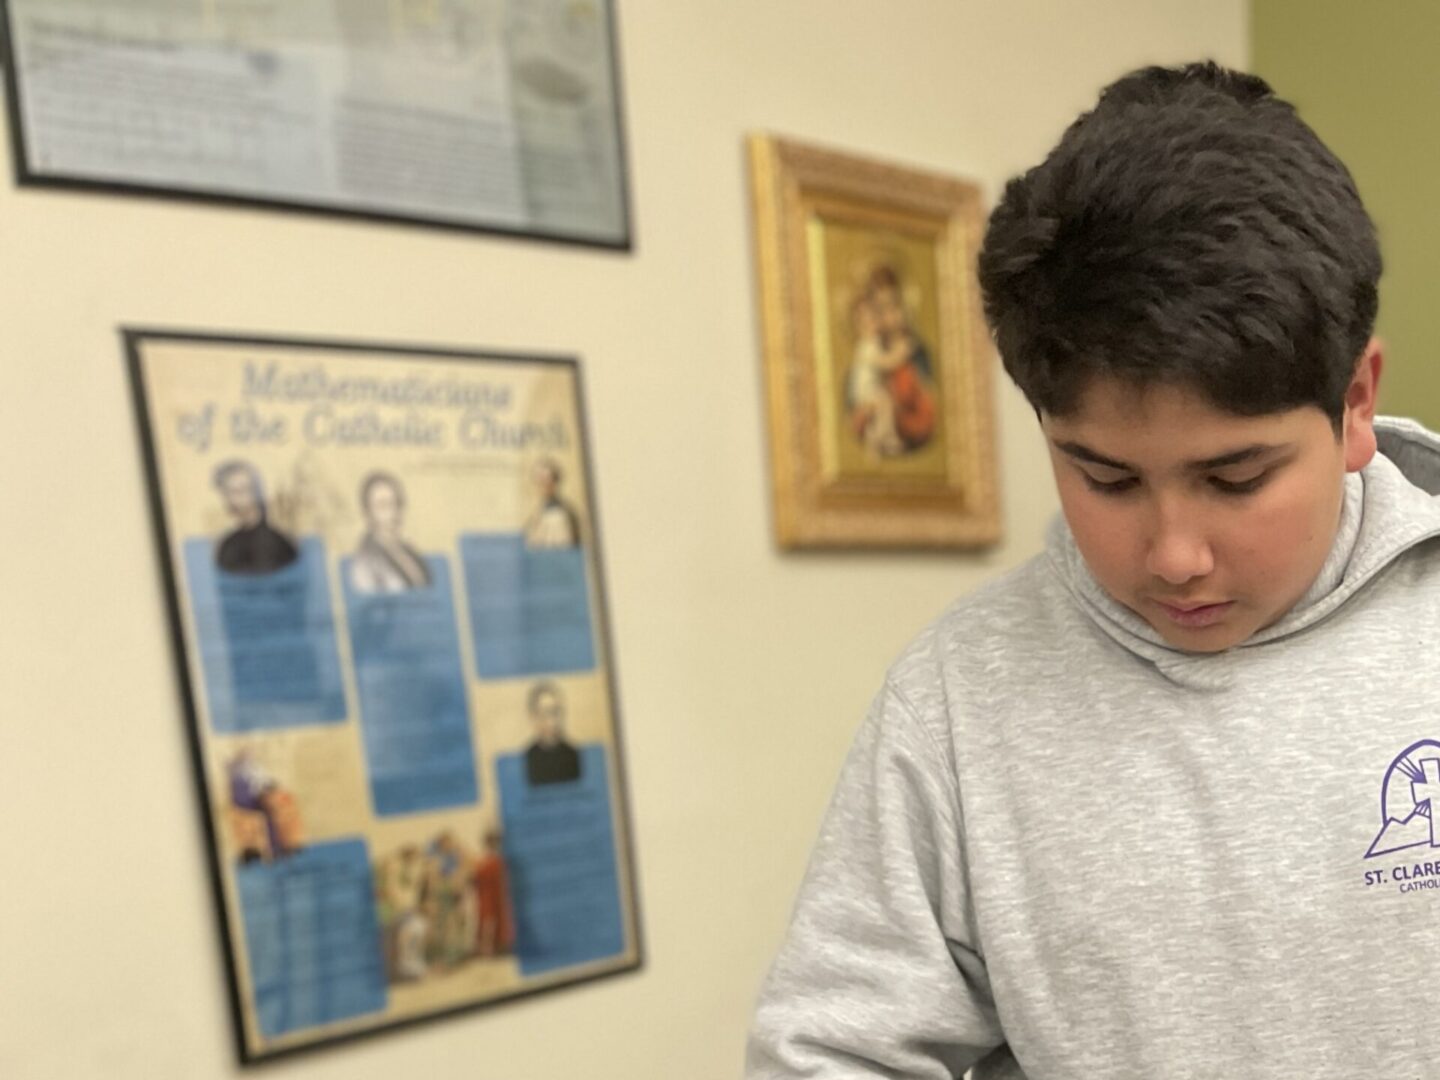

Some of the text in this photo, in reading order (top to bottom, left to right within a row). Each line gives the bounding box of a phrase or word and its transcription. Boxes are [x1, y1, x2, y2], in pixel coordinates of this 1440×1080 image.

[230, 406, 285, 444] the
[302, 406, 445, 448] Catholic
[1364, 870, 1388, 886] ST.
